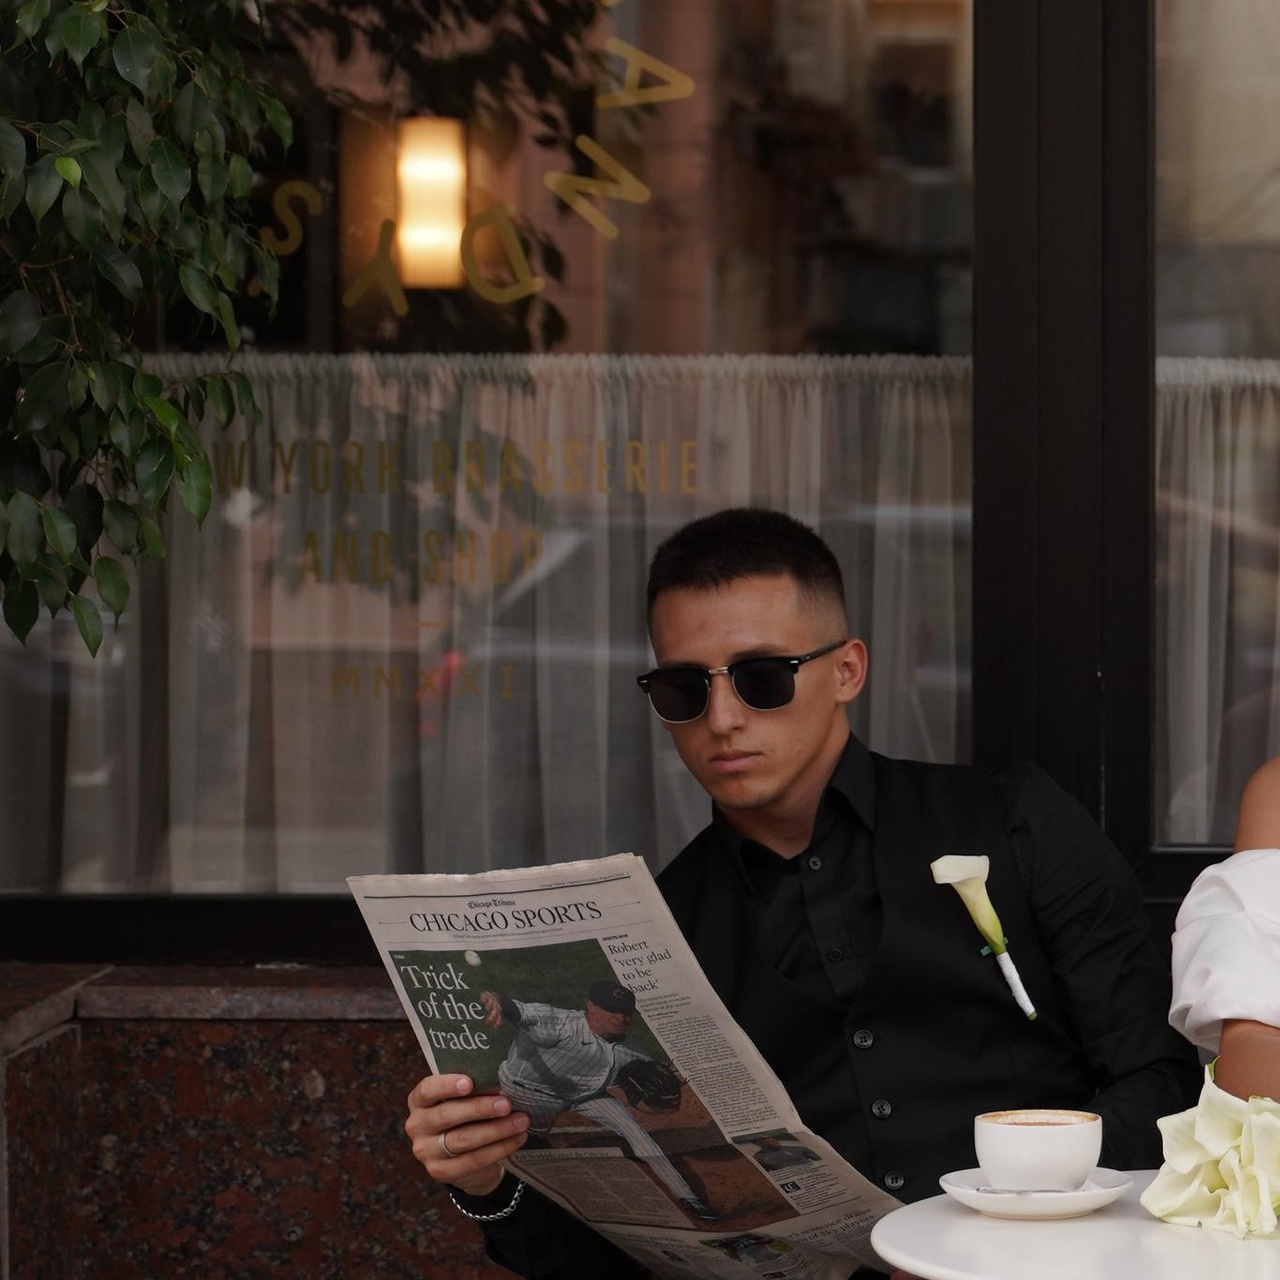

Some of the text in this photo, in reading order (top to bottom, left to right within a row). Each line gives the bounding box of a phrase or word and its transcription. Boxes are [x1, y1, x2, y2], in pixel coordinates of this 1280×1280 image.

[276, 441, 403, 495] YORK
[432, 440, 699, 495] BRASSERIE
[301, 531, 546, 584] AND SHOP
[333, 664, 516, 699] MMXXI
[409, 901, 603, 933] CHICAGO SPORTS
[608, 940, 650, 955] Robert
[614, 949, 672, 968] 'very glad
[400, 963, 471, 990] Trick
[622, 968, 653, 981] to be
[418, 992, 486, 1020] of the
[429, 1024, 491, 1050] trade
